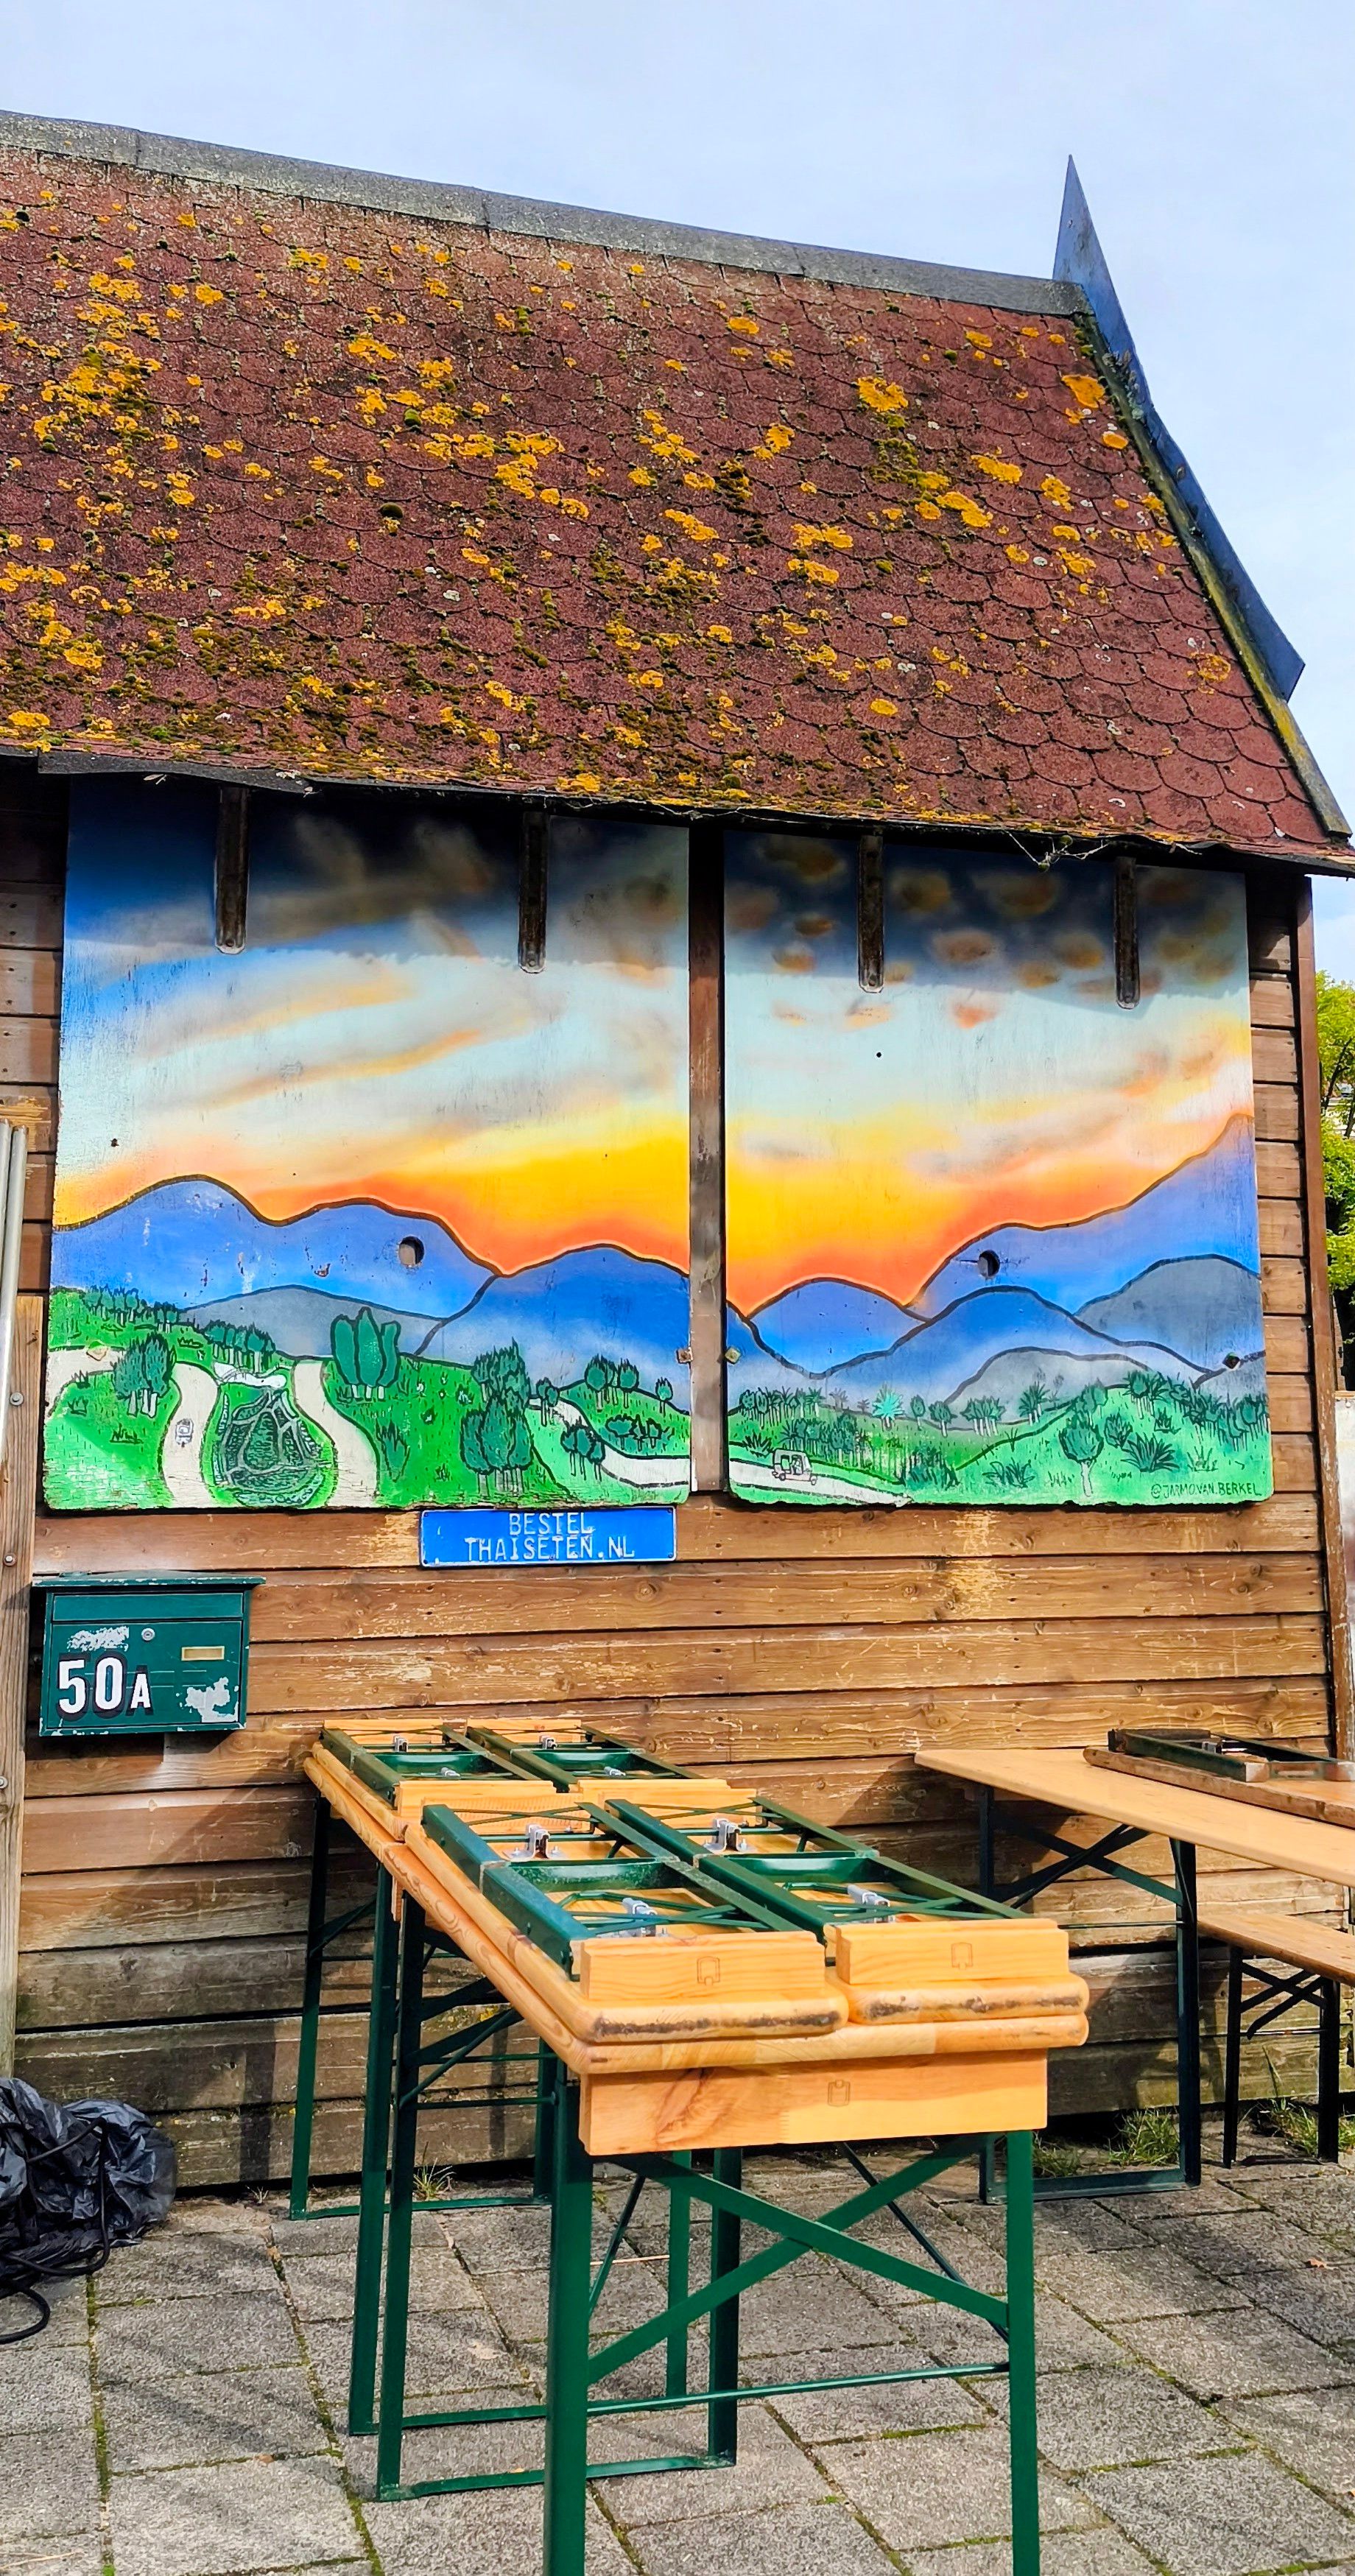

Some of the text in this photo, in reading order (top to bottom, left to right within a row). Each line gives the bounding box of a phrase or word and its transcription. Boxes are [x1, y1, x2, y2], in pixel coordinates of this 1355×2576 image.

[509, 1512, 594, 1536] BESTEL
[464, 1535, 636, 1562] THAISETEN.NL
[58, 1656, 152, 1714] 50A
